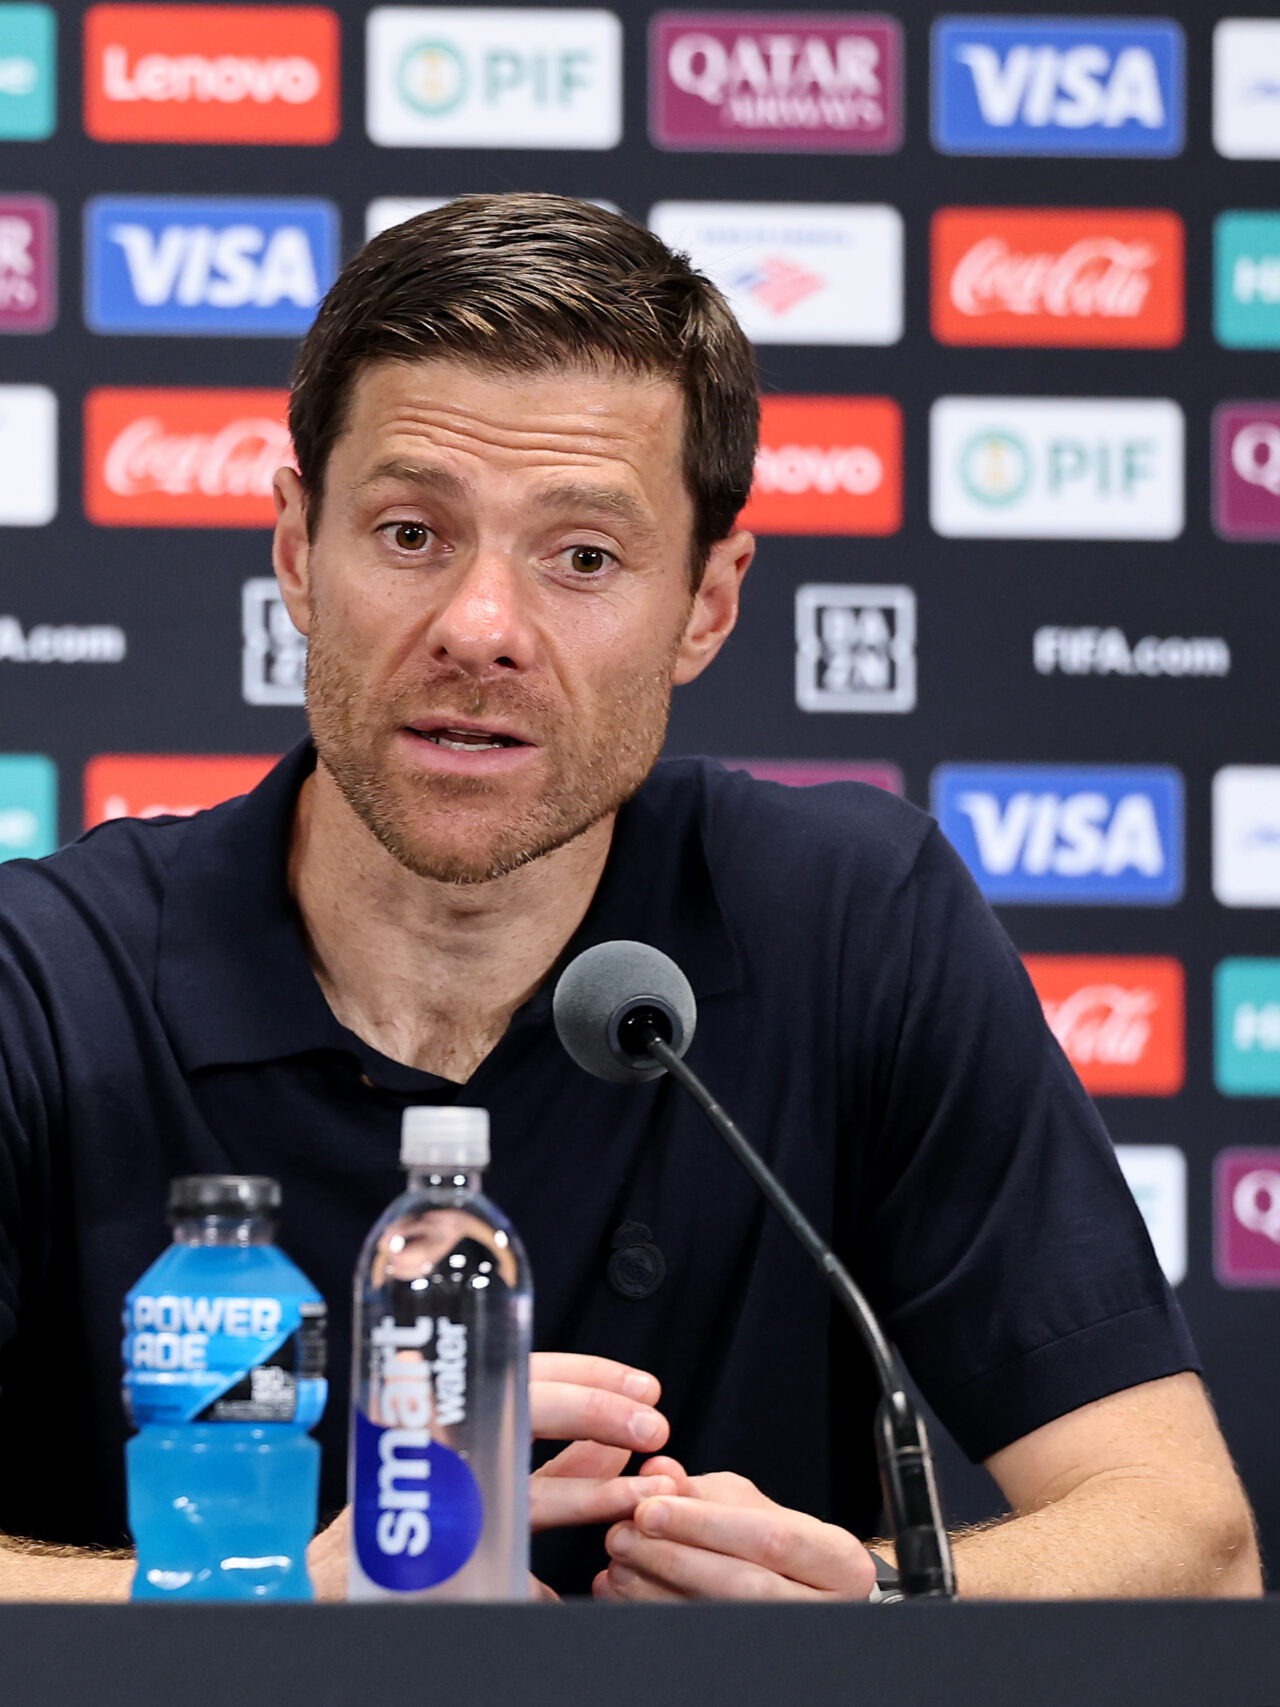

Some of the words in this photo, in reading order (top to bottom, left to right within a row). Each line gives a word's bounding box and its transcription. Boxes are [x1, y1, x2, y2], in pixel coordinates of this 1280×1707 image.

[102, 45, 321, 104] Lenovo
[482, 47, 593, 106] PIF
[668, 33, 881, 106] QATAR
[957, 43, 1166, 129] VISA
[110, 224, 319, 308] VISA
[103, 416, 295, 496] Coca-Col
[1046, 438, 1155, 496] PIF
[1032, 625, 1231, 677] FIFA.com
[957, 791, 1166, 878] VISA
[132, 1295, 283, 1337] POWER
[132, 1332, 210, 1371] ADE
[433, 1314, 468, 1427] water
[372, 1314, 434, 1557] smart
